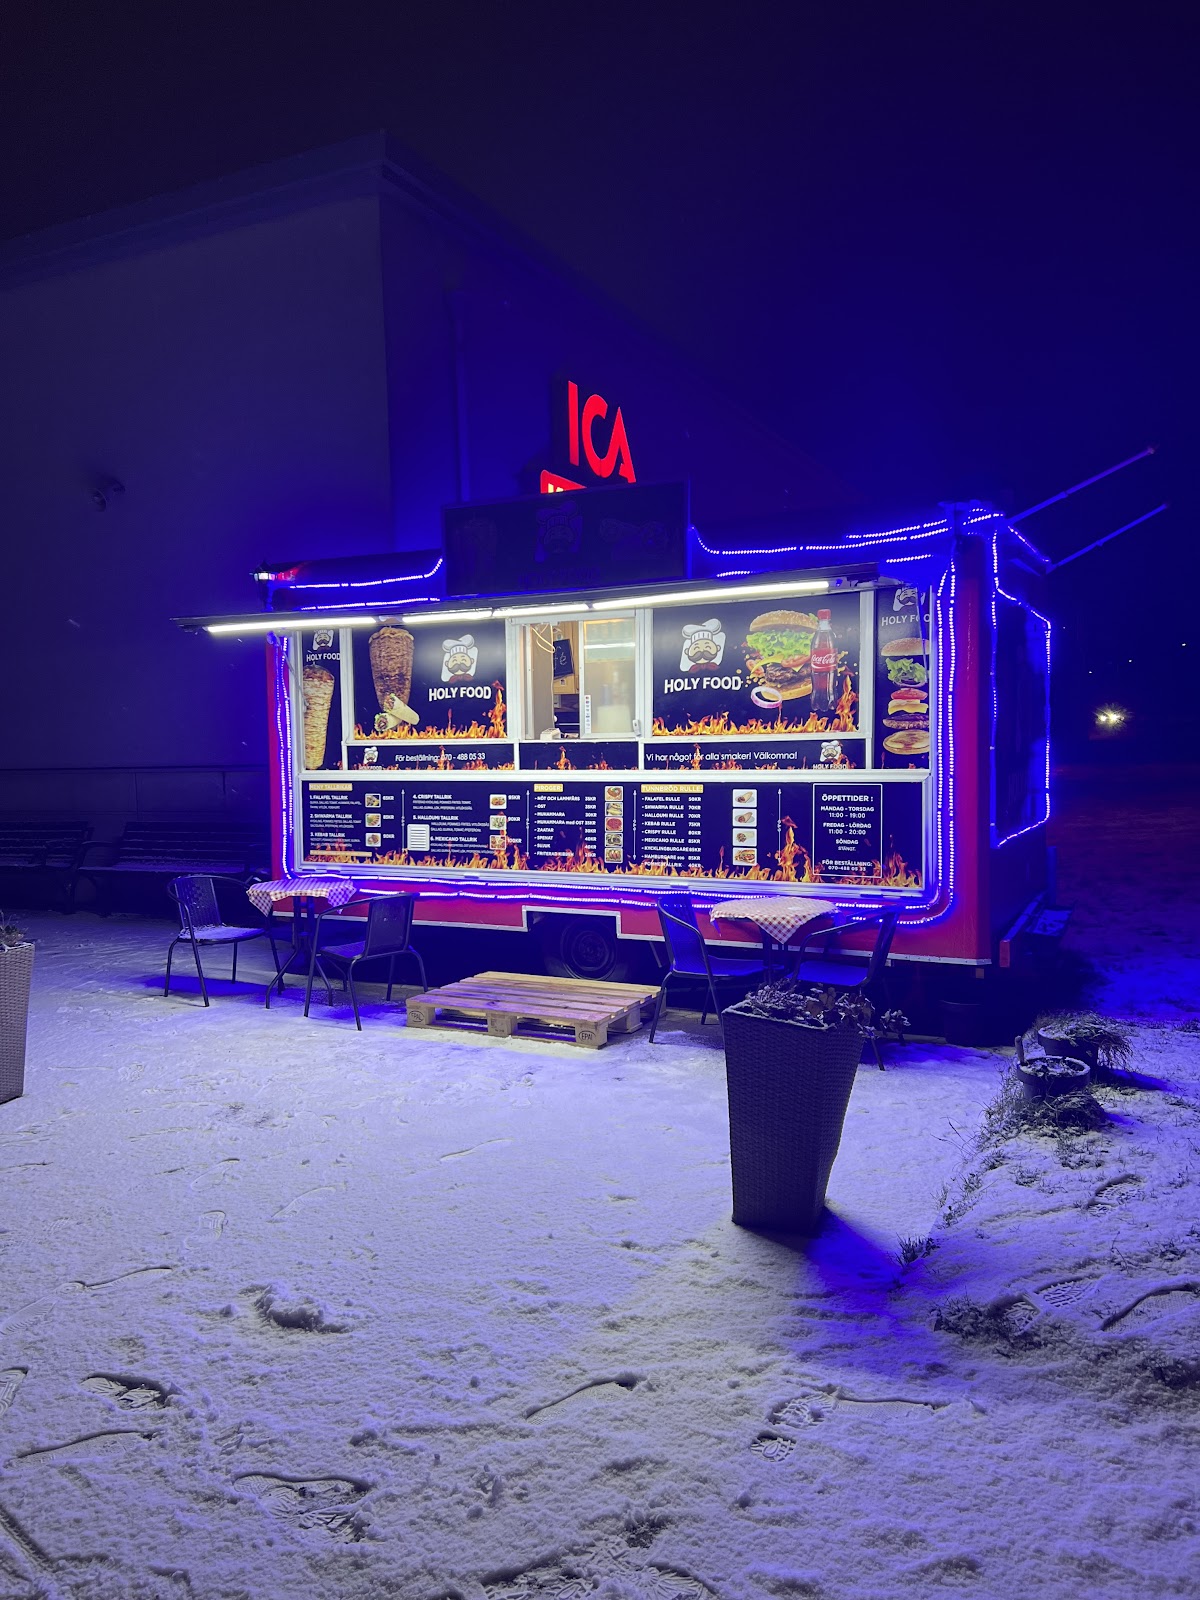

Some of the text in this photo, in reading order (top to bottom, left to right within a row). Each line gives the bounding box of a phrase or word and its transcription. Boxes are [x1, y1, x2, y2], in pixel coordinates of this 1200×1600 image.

[568, 380, 636, 483] ICA
[881, 615, 908, 627] HOLY
[306, 652, 341, 662] HOLY FOOD
[664, 676, 742, 694] HOLY FOOD
[428, 686, 492, 702] HOLY FOOD
[395, 754, 405, 762] För
[669, 753, 692, 763] något
[693, 753, 704, 761] för
[720, 752, 751, 760] smaker!
[753, 751, 798, 760] Välkomna!
[821, 793, 869, 802] ÖPPETTIDER
